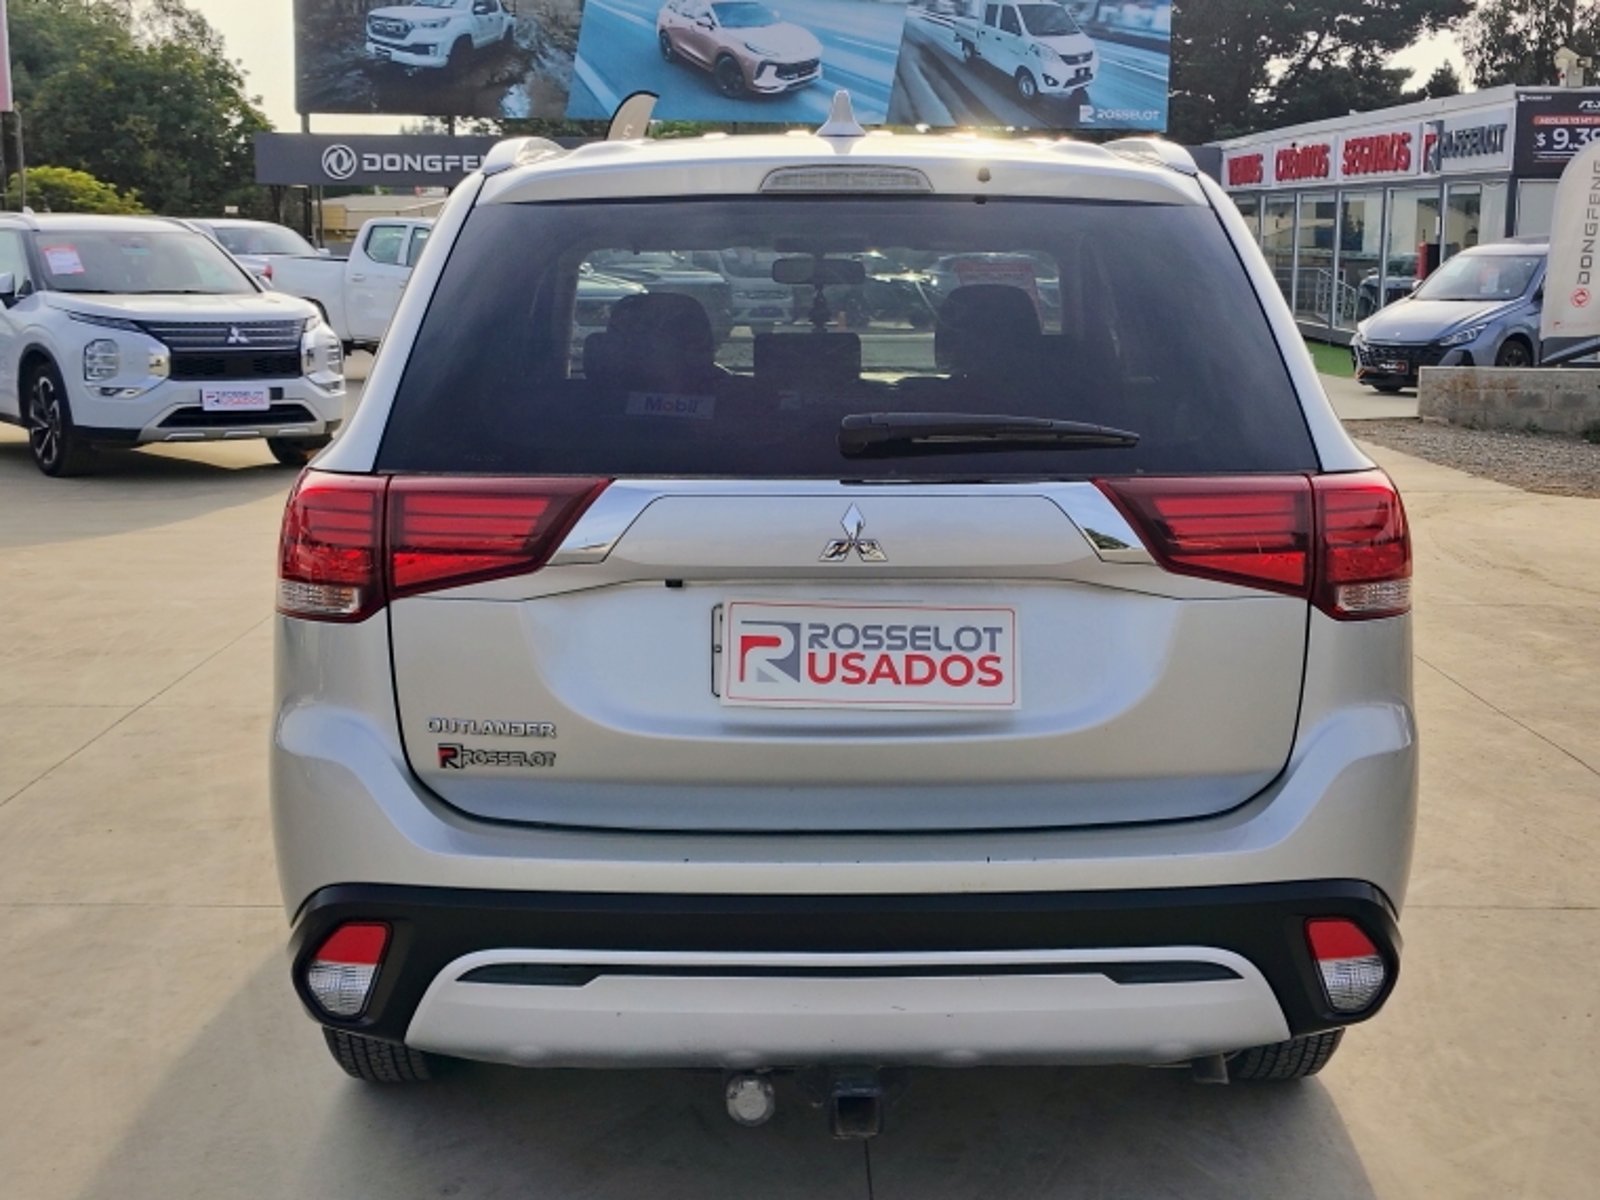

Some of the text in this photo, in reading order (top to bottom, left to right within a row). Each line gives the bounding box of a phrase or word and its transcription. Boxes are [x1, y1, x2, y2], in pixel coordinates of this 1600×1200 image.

[1096, 108, 1161, 121] ROSSELOT
[362, 153, 486, 173] DONGFE
[807, 622, 1003, 652] ROSSELOT
[807, 651, 1004, 687] USADOS
[426, 717, 558, 738] OUTLANDER
[462, 749, 557, 768] ROSSELOT
